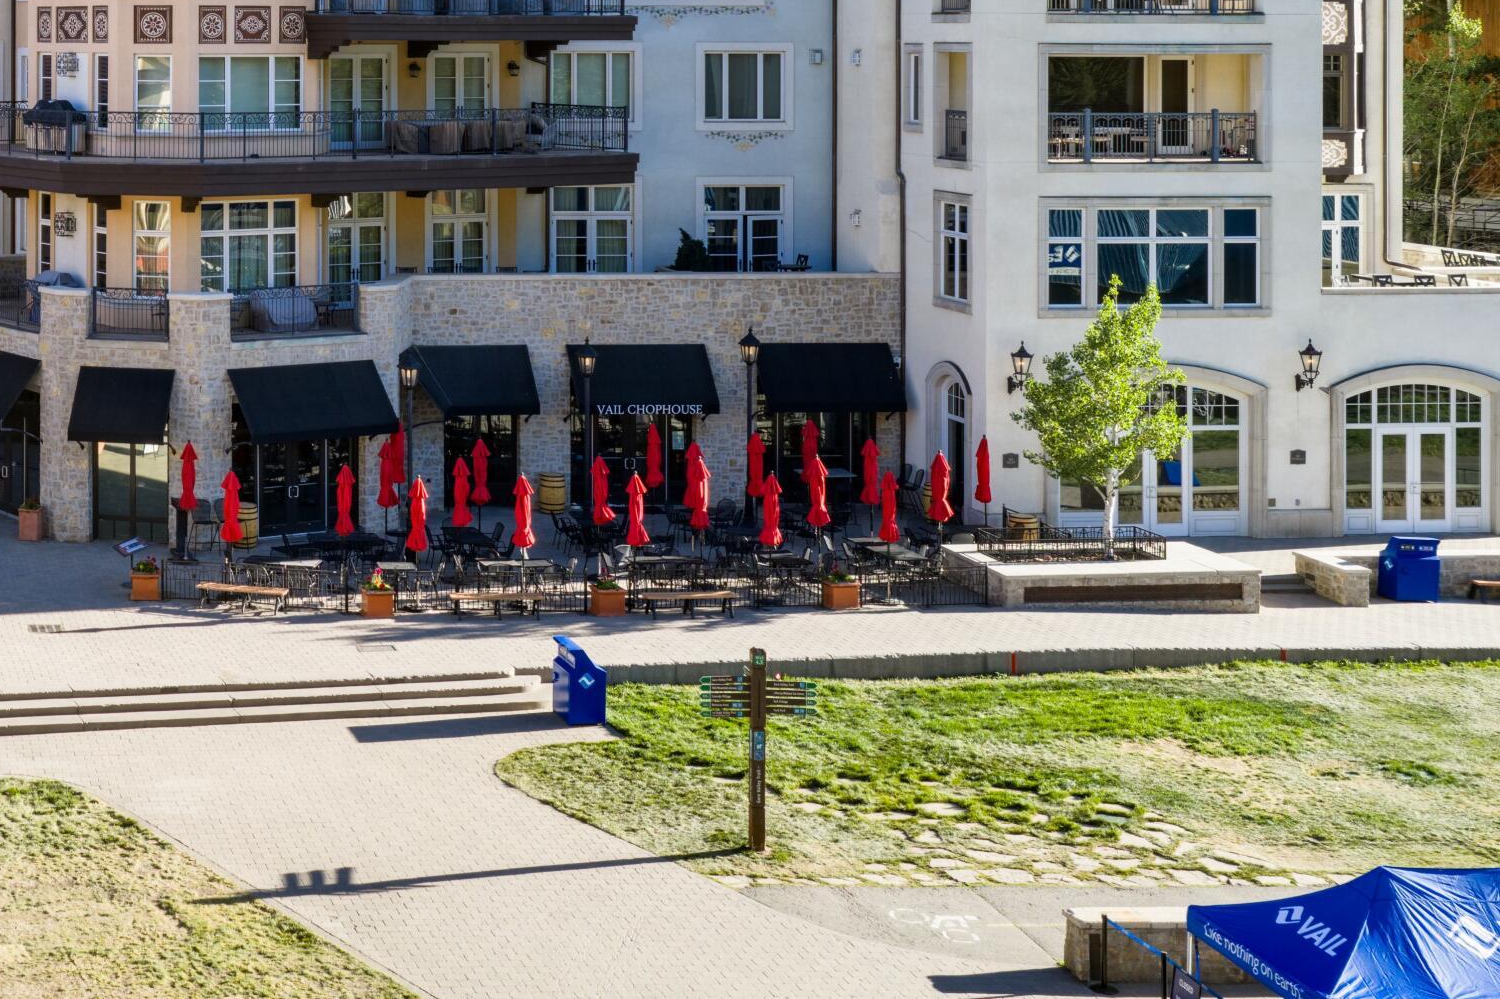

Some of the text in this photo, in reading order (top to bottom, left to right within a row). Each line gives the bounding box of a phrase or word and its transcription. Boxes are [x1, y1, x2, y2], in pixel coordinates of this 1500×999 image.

[596, 404, 703, 415] VAIL CHOPHOUSE
[1297, 915, 1347, 957] VAIL
[1223, 936, 1260, 976] nothing
[1260, 963, 1274, 981] on
